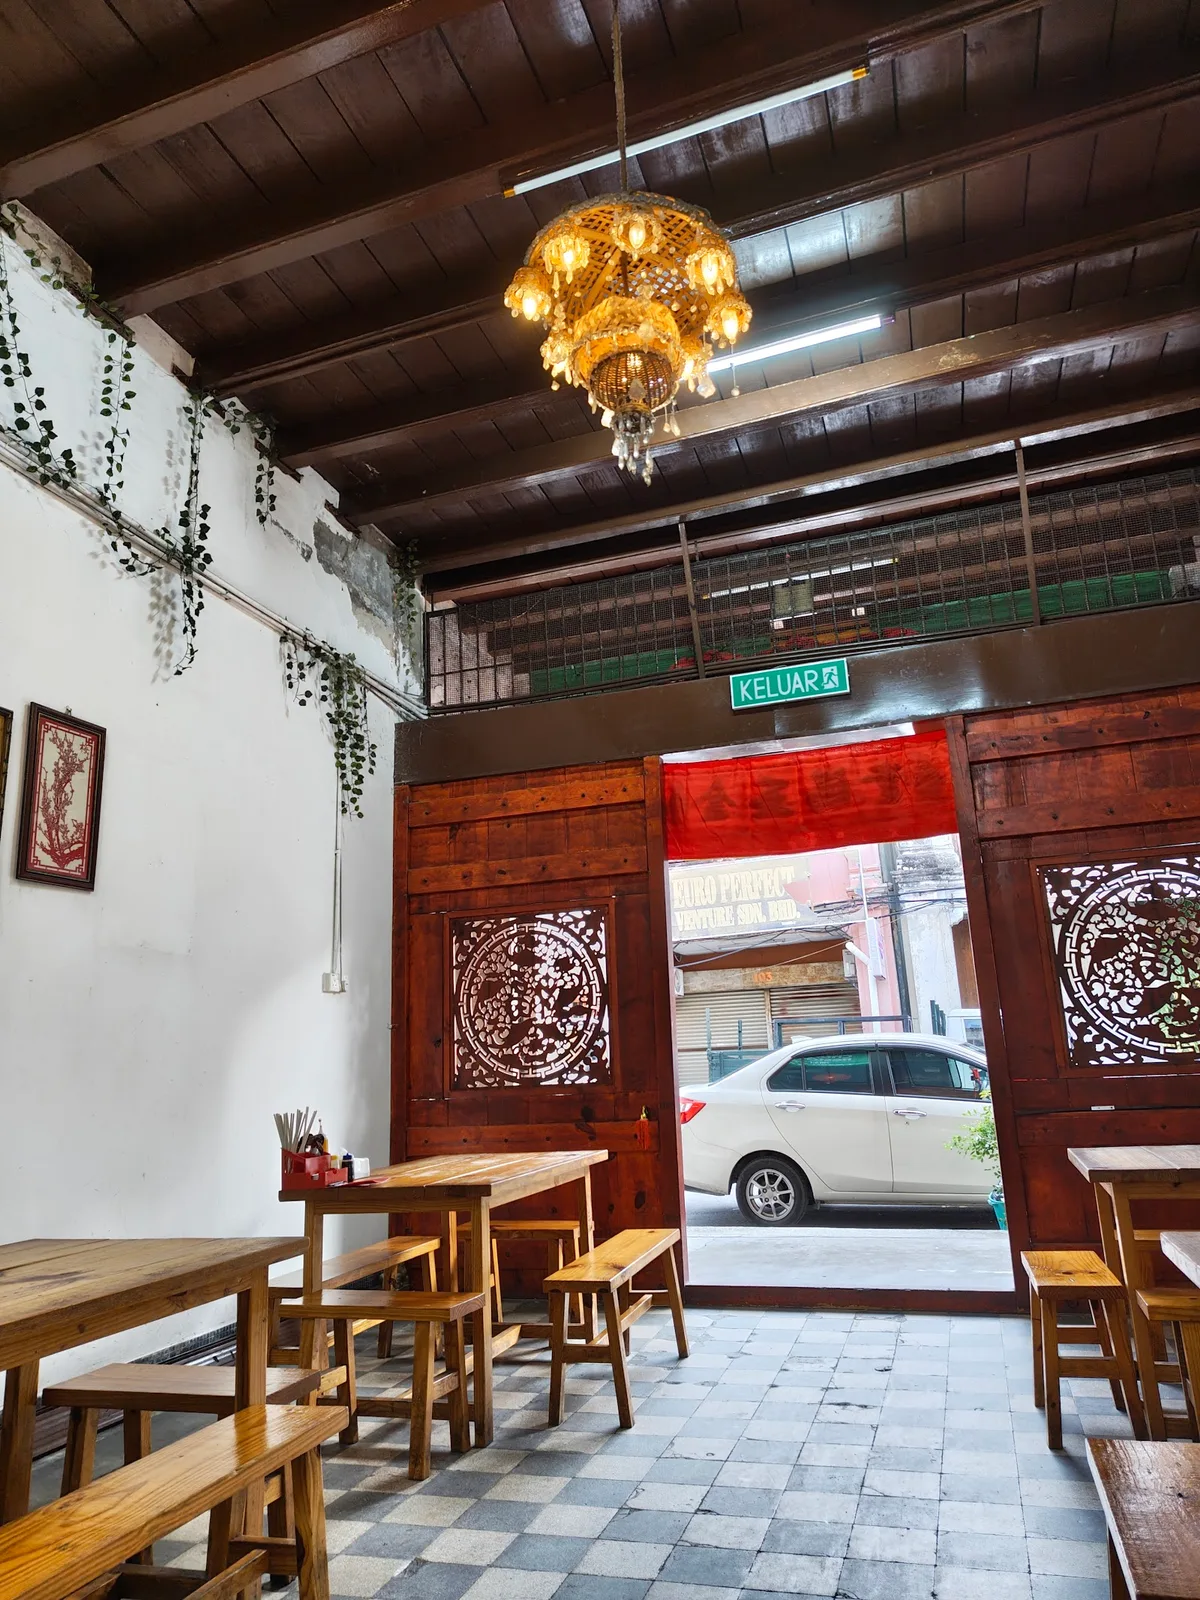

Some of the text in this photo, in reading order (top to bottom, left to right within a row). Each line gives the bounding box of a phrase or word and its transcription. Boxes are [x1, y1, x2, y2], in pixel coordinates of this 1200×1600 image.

[740, 669, 819, 701] KELUAR
[672, 866, 795, 908] EURO PERFECT
[675, 905, 734, 931] VENTURE
